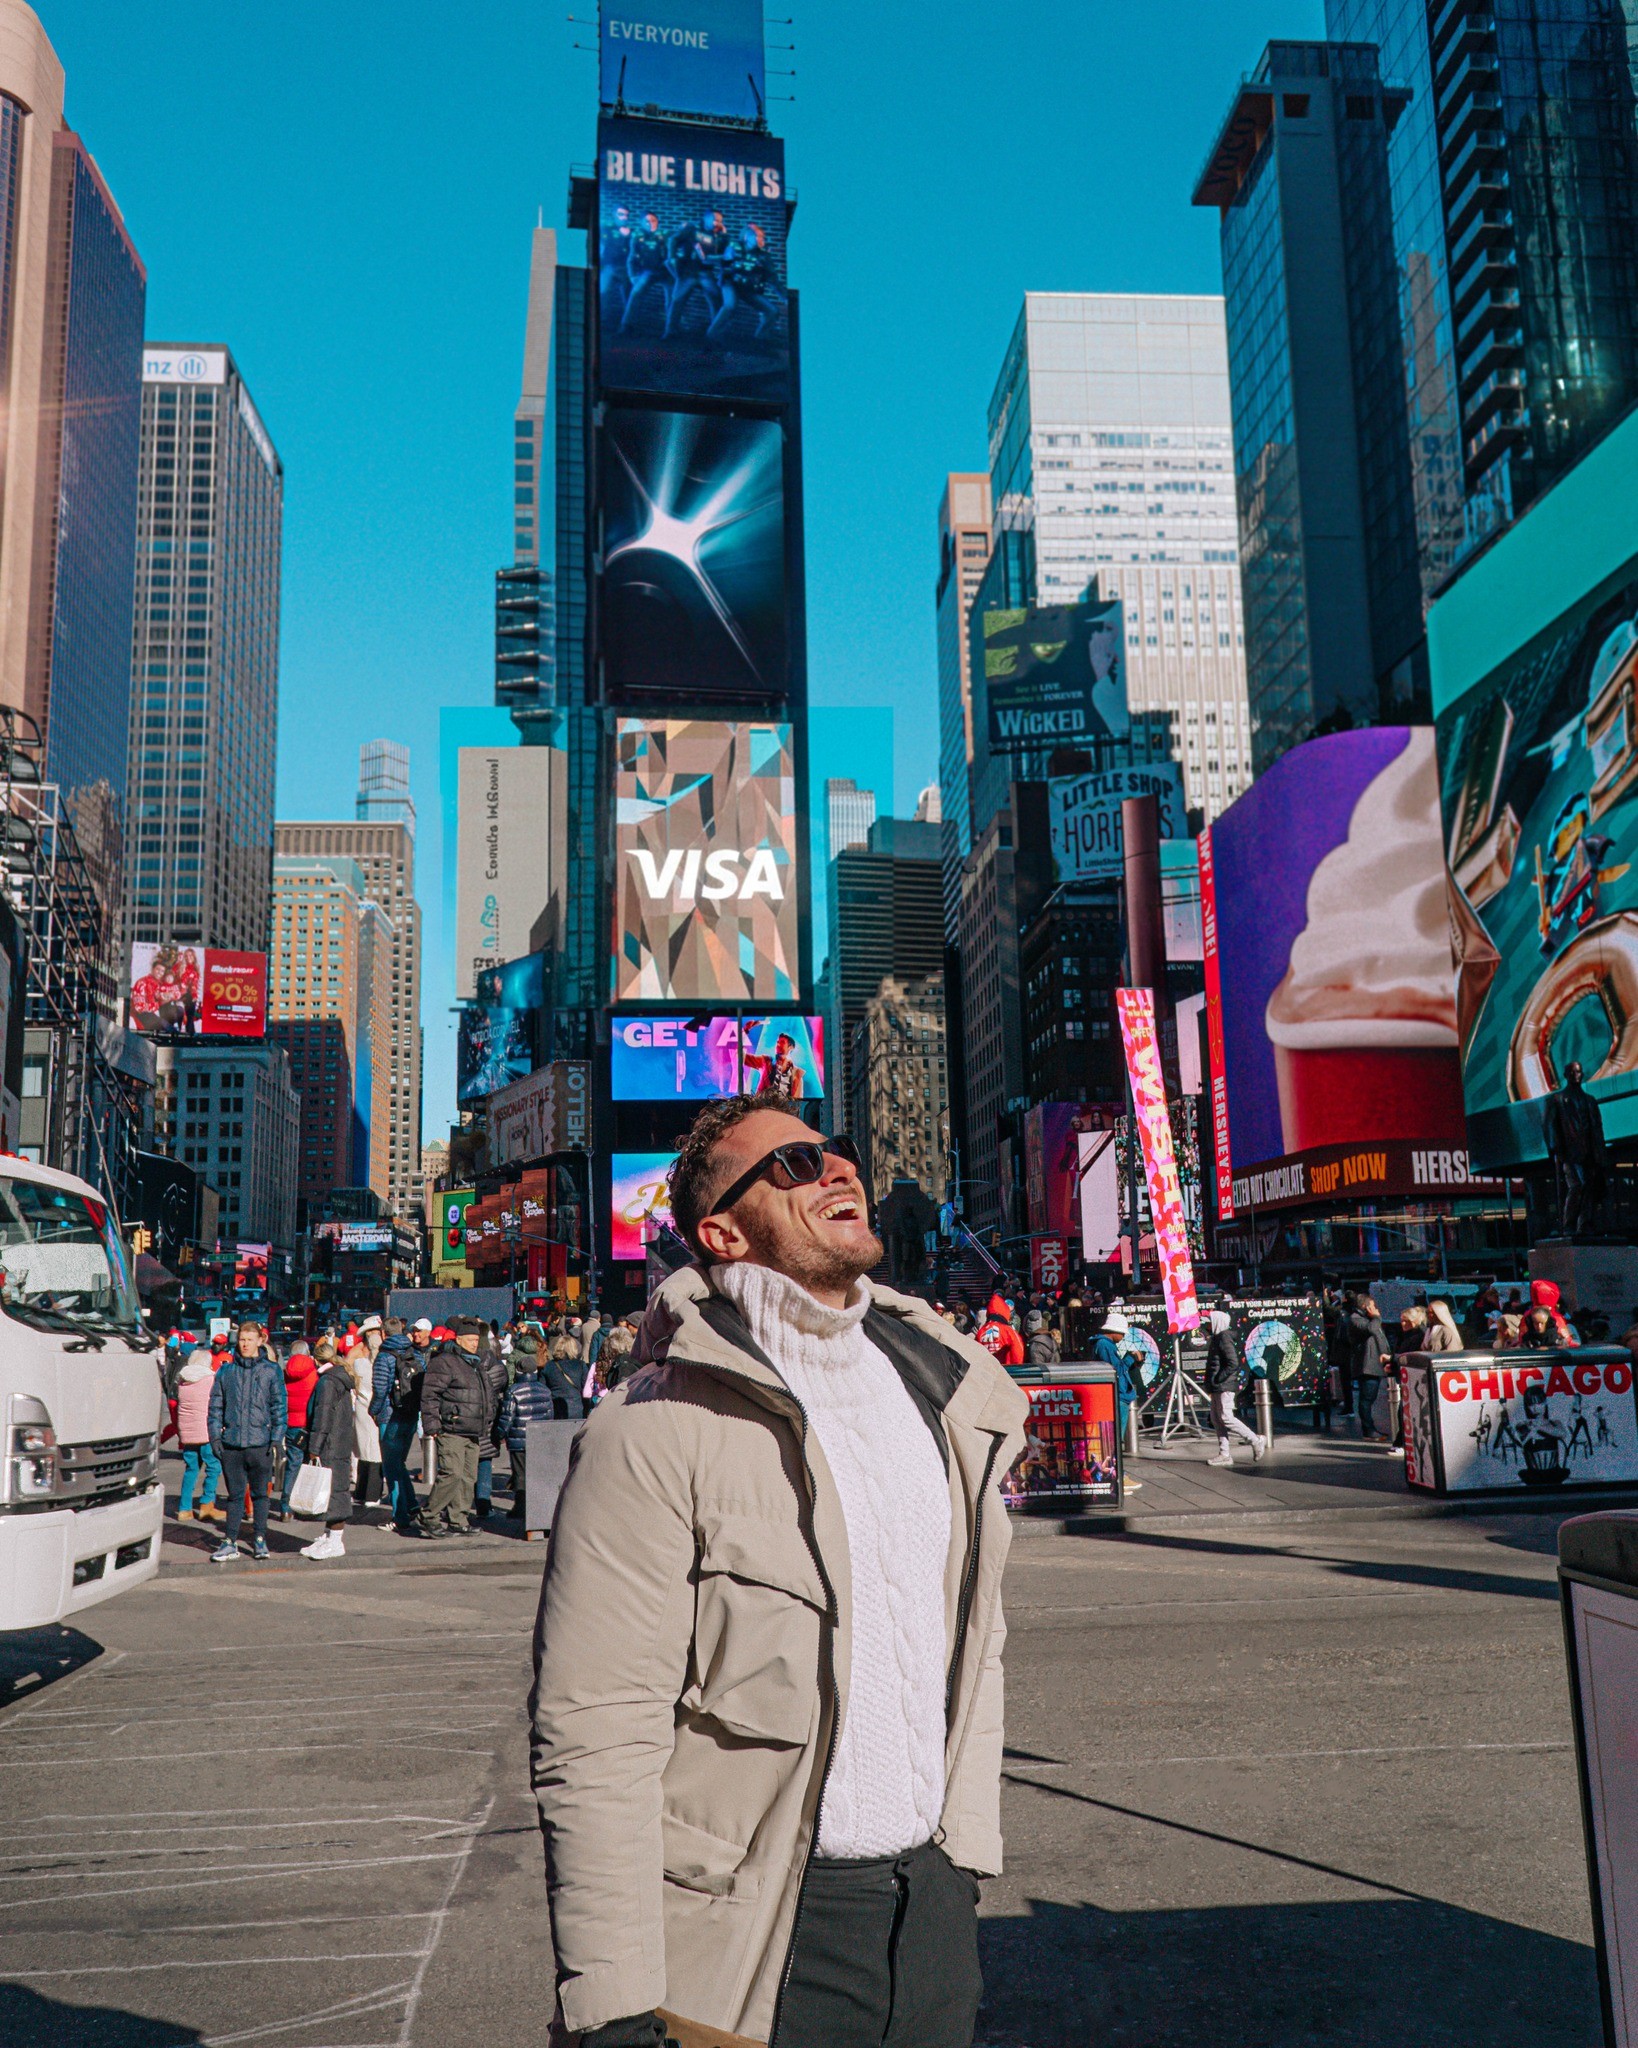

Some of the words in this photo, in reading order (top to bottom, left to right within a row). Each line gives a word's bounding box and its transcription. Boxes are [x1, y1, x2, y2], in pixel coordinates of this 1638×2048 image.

[609, 20, 709, 49] EVERYONE
[606, 150, 675, 187] BLUE
[685, 158, 780, 198] LIGHTS
[1040, 683, 1060, 691] LIVE
[1044, 690, 1084, 701] FOREVER
[1063, 773, 1123, 812] LITTLE
[1128, 773, 1173, 799] SHOP
[1064, 805, 1174, 868] HORRS
[625, 849, 784, 900] VISA
[623, 1021, 708, 1048] GET
[567, 1066, 586, 1146] HELLO!
[1213, 1076, 1231, 1189] HERSHEY'S
[1311, 1161, 1341, 1195] SHOP
[1343, 1152, 1387, 1187] NOW
[341, 1233, 392, 1244] AMSTERDAM
[1039, 1240, 1063, 1287] tkts
[1229, 1301, 1245, 1309] POST
[1246, 1300, 1262, 1308] YOUR
[1276, 1299, 1298, 1307] YEAR'S
[1028, 1389, 1074, 1403] YOUR
[1440, 1362, 1633, 1403] CHICAGO
[1044, 1403, 1083, 1416] LIST.
[1400, 1366, 1416, 1482] CHICAGO
